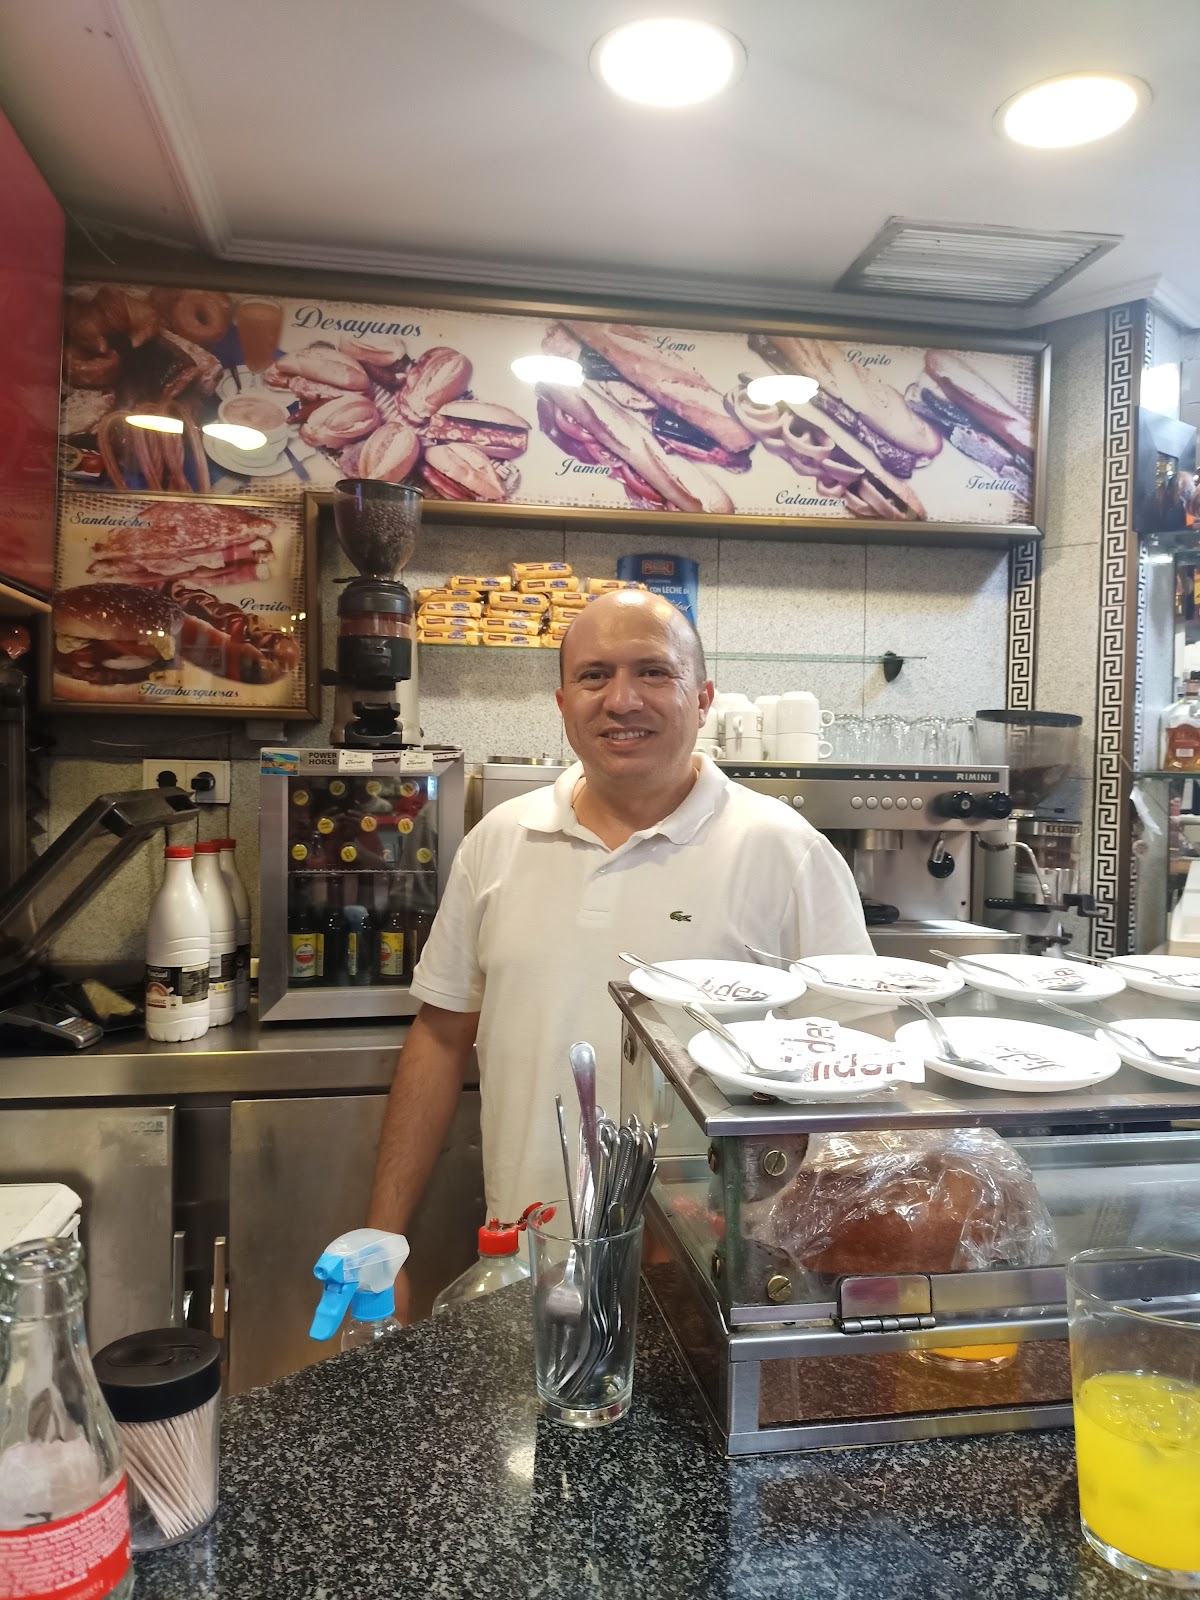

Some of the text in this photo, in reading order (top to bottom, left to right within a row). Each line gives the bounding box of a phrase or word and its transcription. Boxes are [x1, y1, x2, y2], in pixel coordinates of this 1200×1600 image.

[291, 305, 422, 339] Desayunos
[653, 335, 696, 352] Lomo
[844, 349, 892, 368] Pepito
[555, 458, 610, 477] Jamon
[966, 475, 1017, 491] Tortilla
[775, 490, 847, 507] Calamares
[69, 511, 152, 528] Sandwiches
[662, 586, 682, 595] LECHE
[240, 597, 291, 612] Perritos
[138, 682, 240, 699] Hamburguesas
[956, 772, 992, 781] RIMINI
